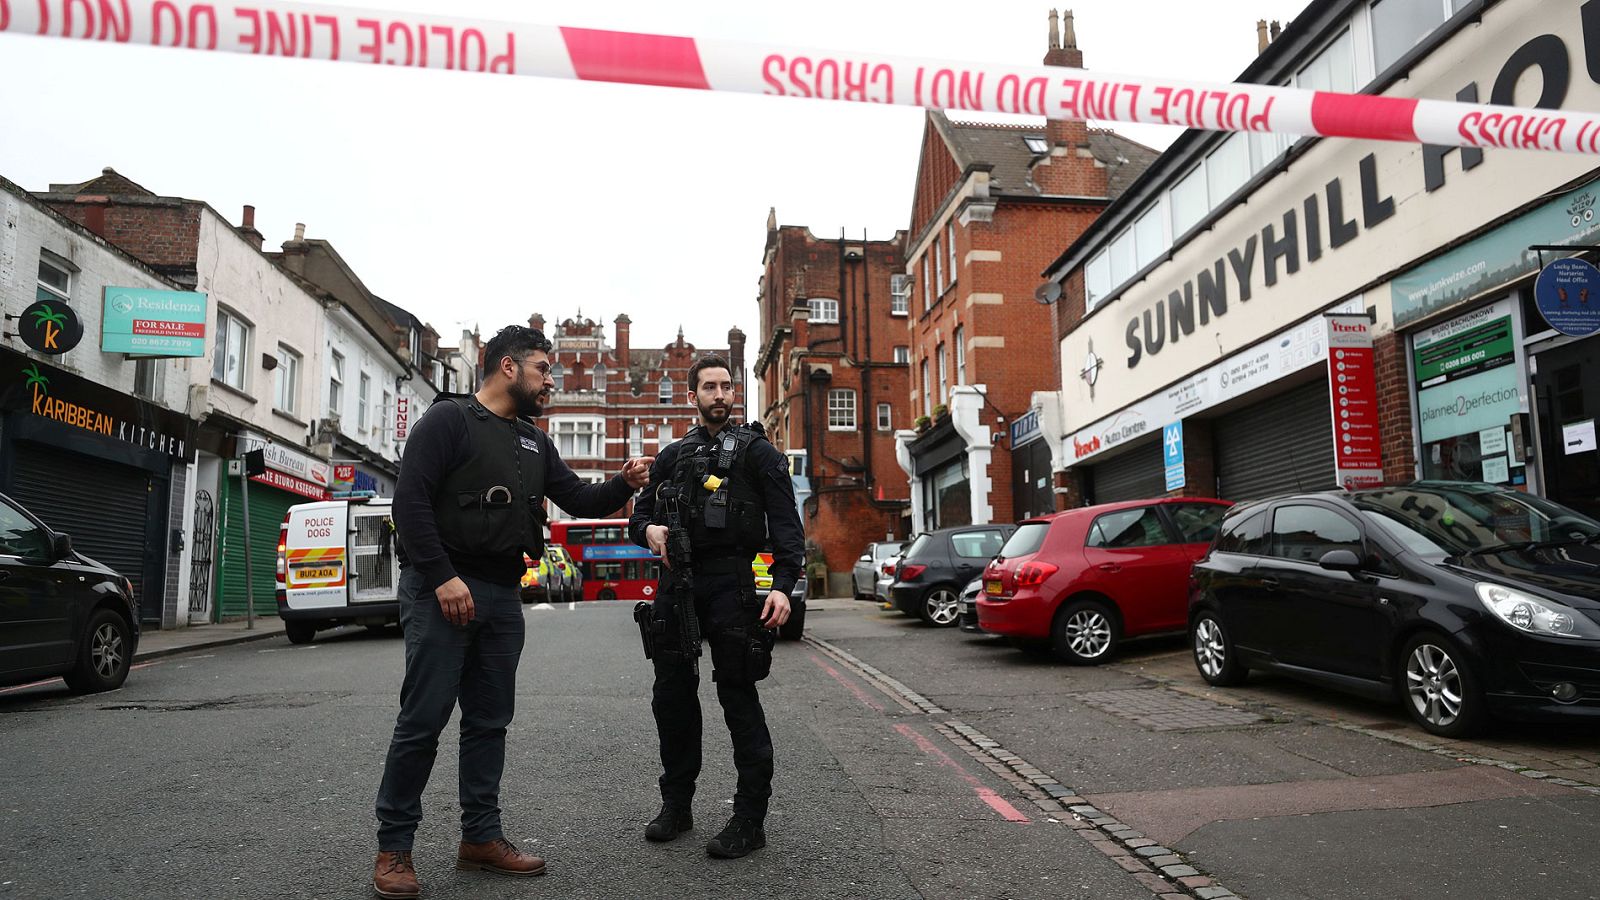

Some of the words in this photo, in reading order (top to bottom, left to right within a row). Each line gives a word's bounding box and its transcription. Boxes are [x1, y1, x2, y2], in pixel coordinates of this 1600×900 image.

[234, 8, 340, 61] LINE
[356, 19, 515, 75] POLICE
[762, 54, 894, 105] CROSS
[995, 73, 1049, 116] DO
[1060, 79, 1142, 122] LINE
[1150, 86, 1276, 133] POLICE
[1125, 152, 1397, 369] SUNNYHILL
[1408, 260, 1486, 302] www.junkwize.com
[137, 297, 201, 313] Residenza
[131, 337, 147, 345] 020
[136, 320, 157, 329] FOR
[159, 322, 185, 331] SALE
[1422, 386, 1519, 425] planned2perfection
[119, 421, 185, 458] KITCHEN
[1104, 431, 1121, 446] Auto
[1121, 420, 1147, 439] Centre
[279, 449, 305, 471] Bureau
[274, 472, 295, 488] BIURO
[305, 517, 334, 527] POLICE
[307, 527, 331, 538] DOGS
